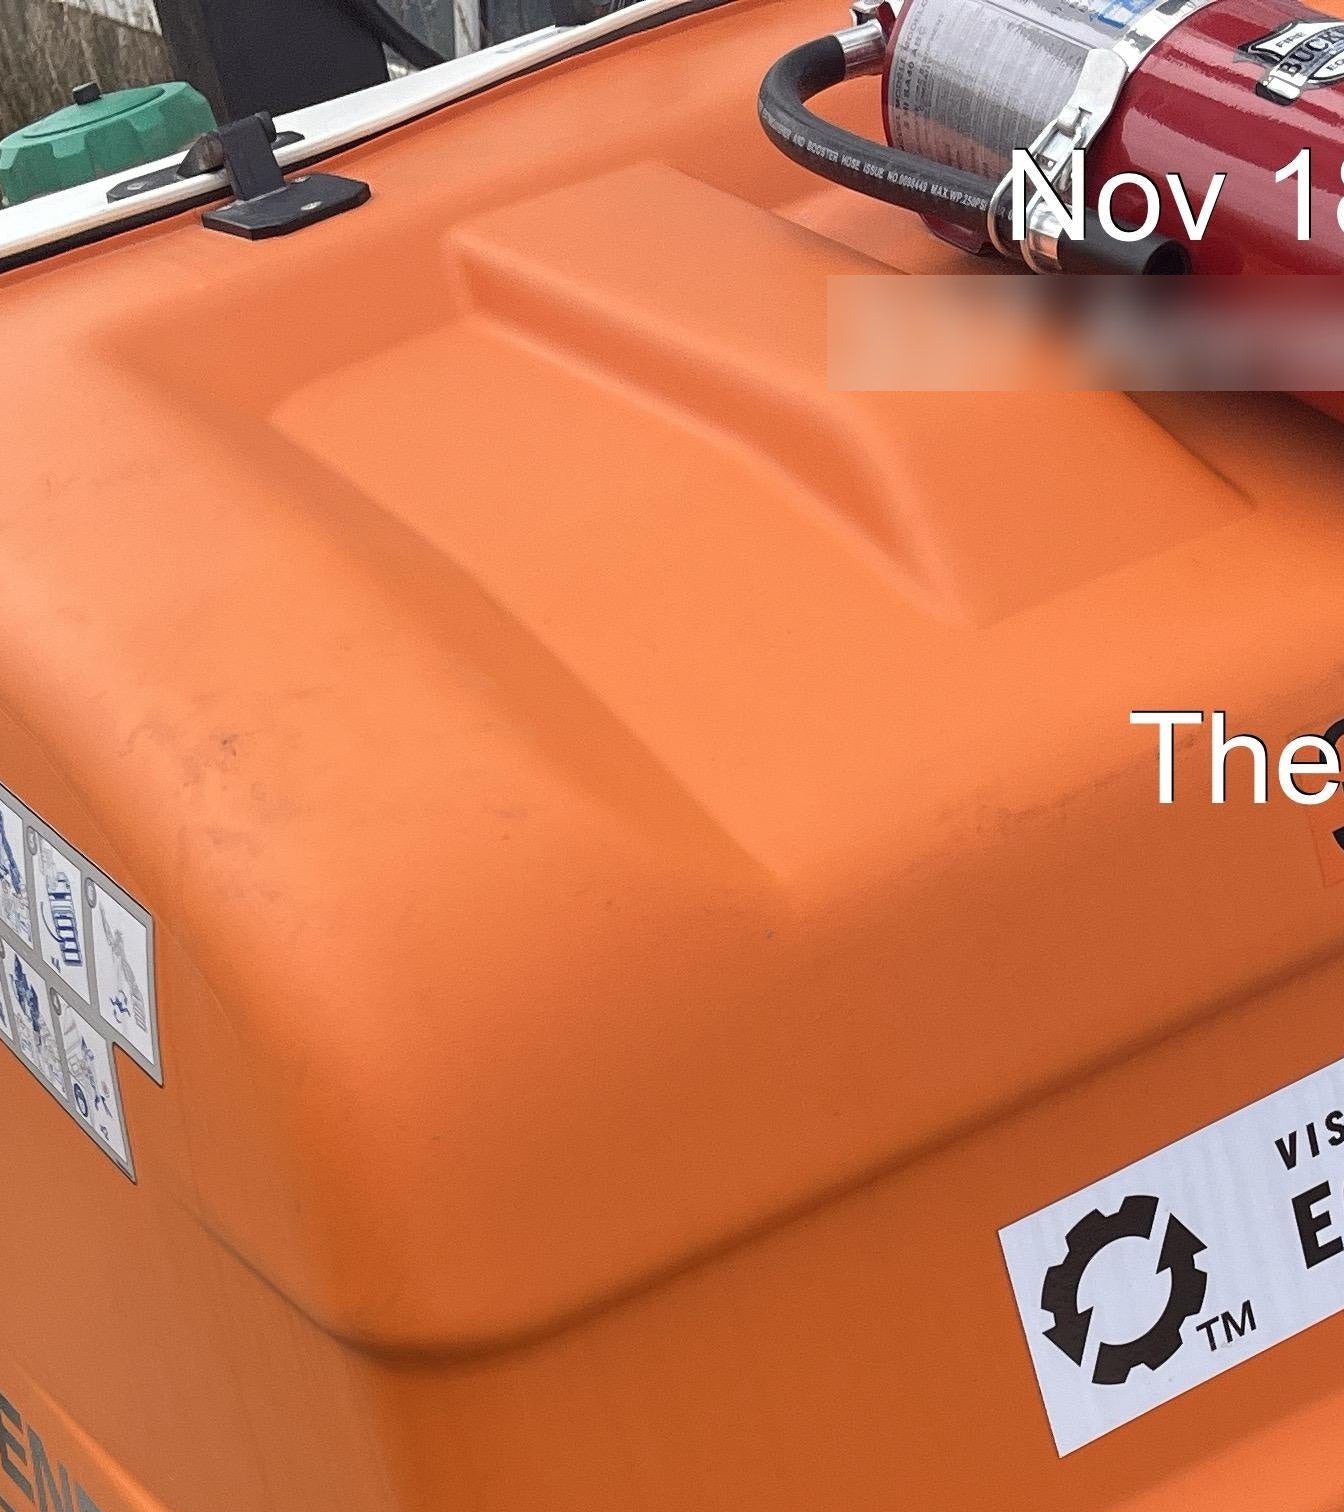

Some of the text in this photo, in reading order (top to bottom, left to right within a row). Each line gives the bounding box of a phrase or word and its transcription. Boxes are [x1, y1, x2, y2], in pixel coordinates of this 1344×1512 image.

[806, 140, 839, 162] BOOSTER
[841, 154, 860, 171] HOSE
[863, 162, 884, 179] ISSUE
[1195, 1299, 1258, 1352] TM
